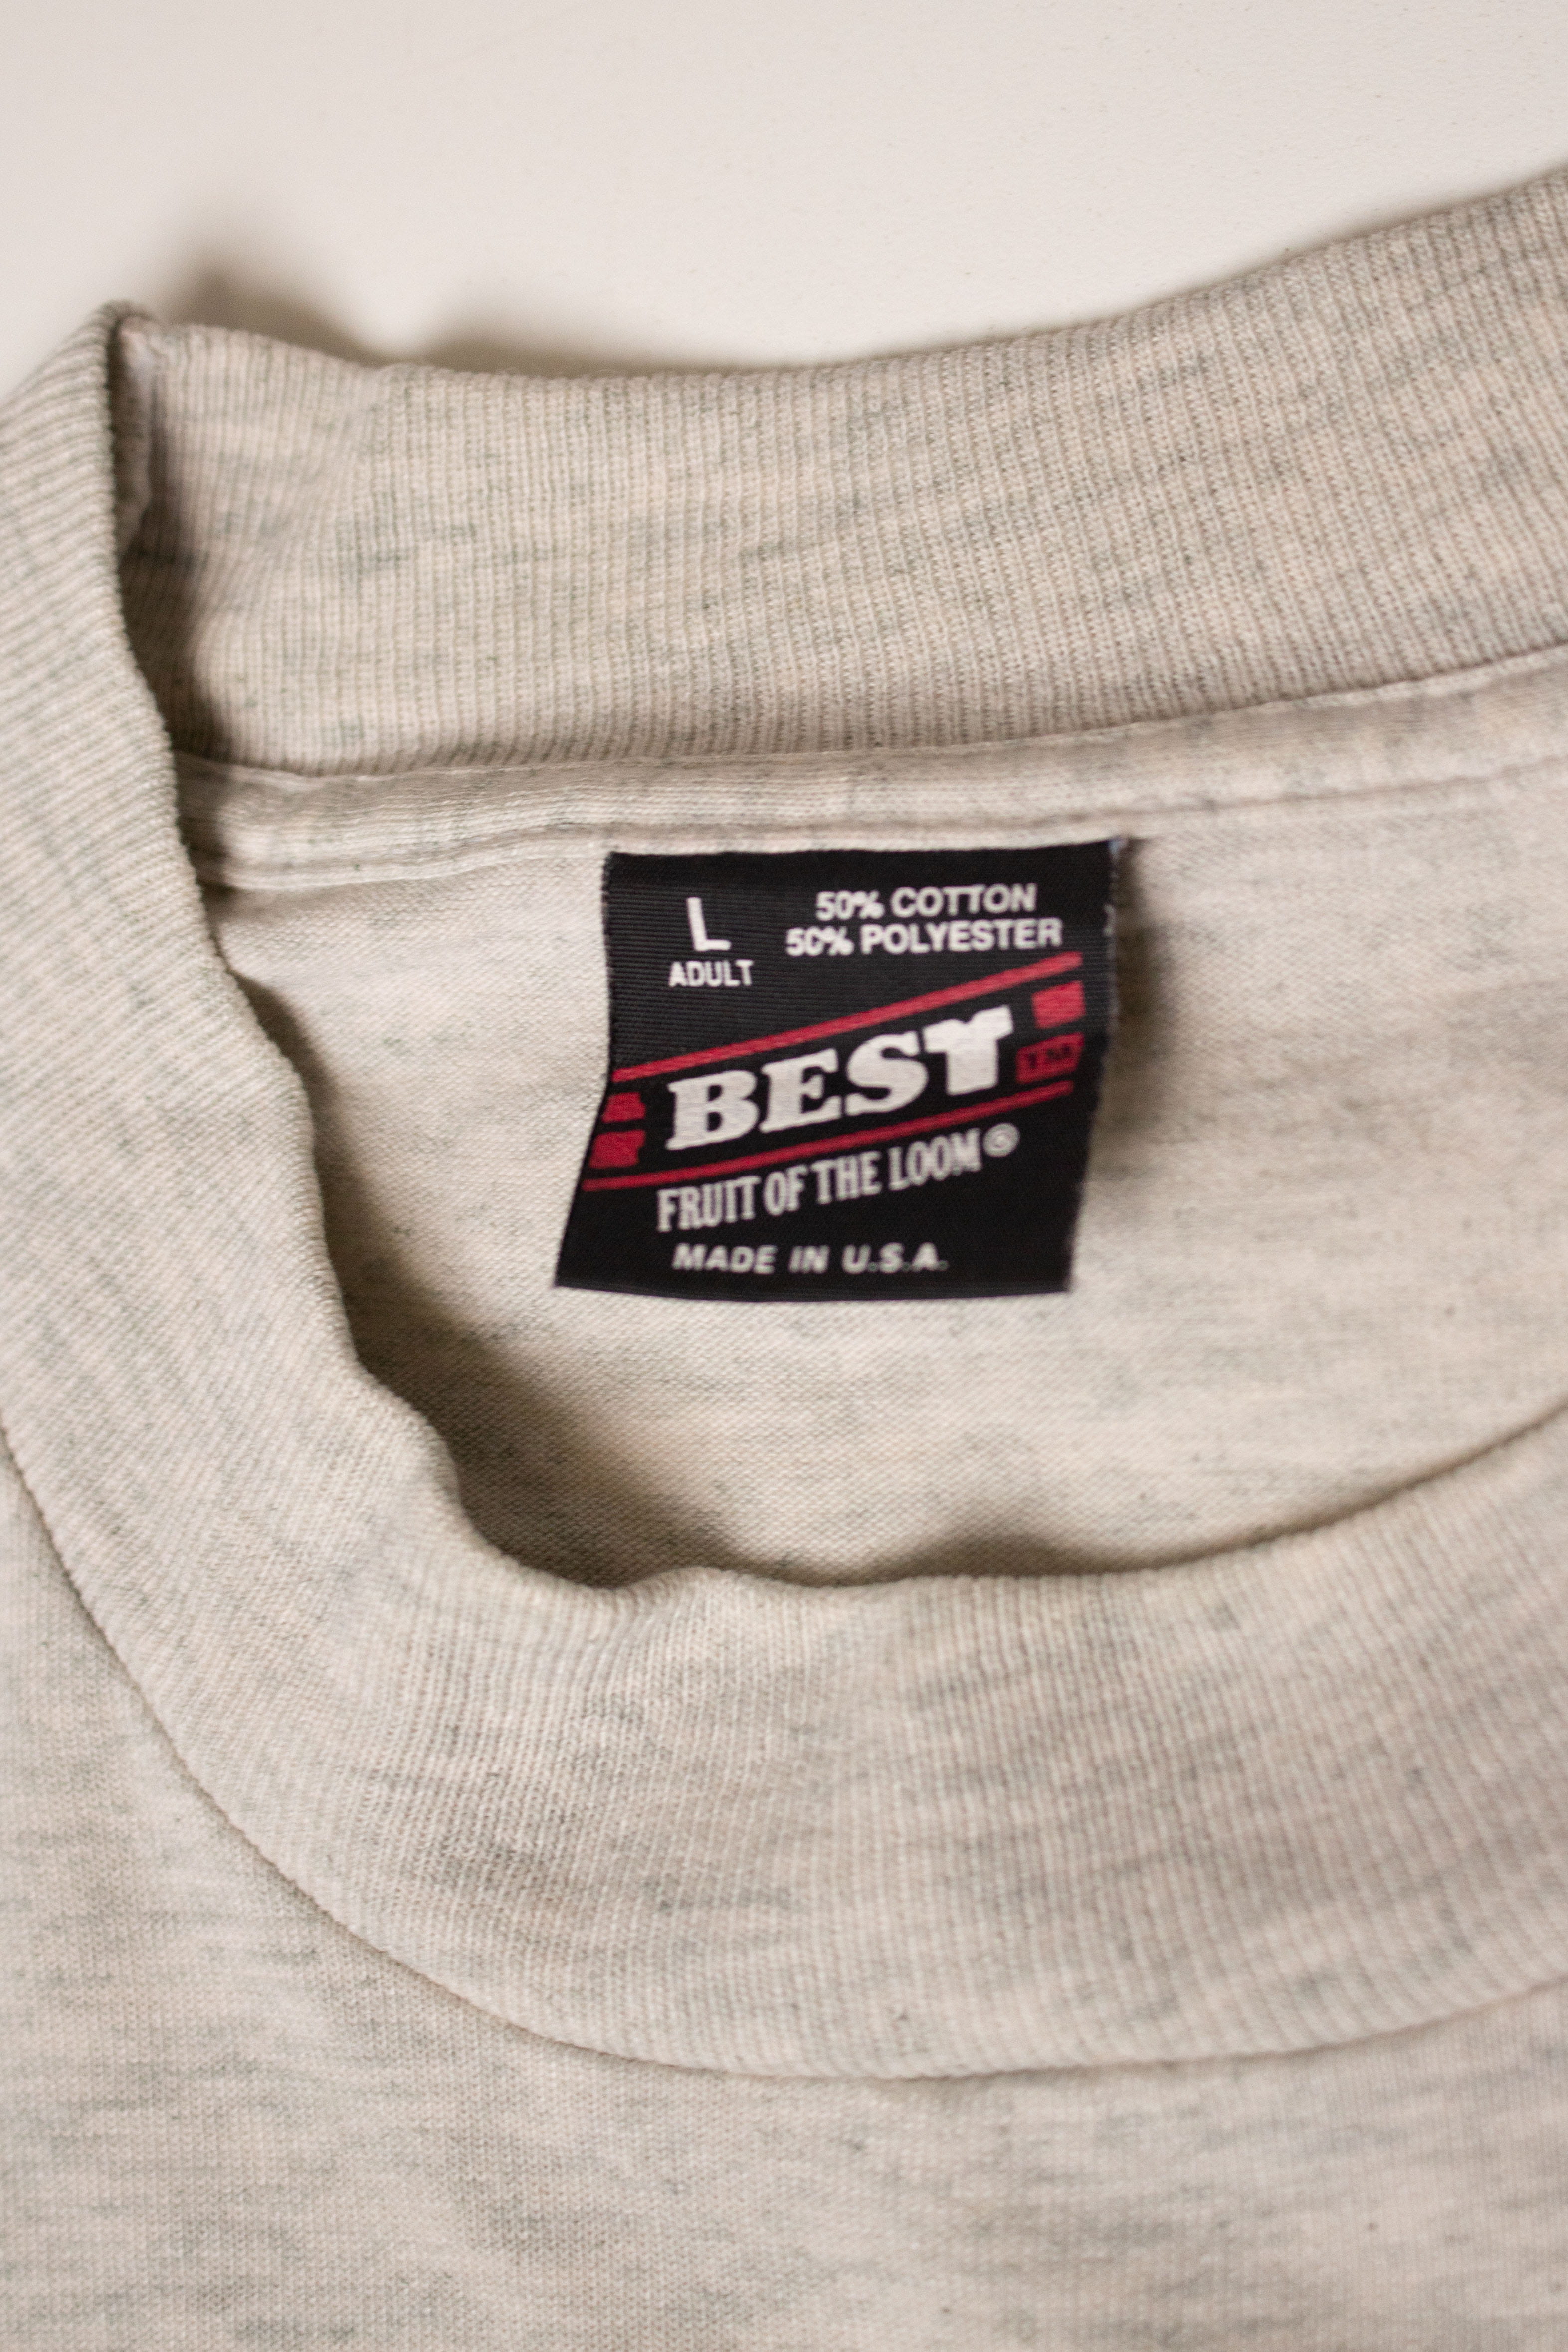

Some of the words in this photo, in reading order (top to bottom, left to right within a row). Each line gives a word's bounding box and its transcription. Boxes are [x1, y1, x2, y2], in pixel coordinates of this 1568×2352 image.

[815, 890, 884, 921] 50%
[890, 883, 1038, 917] COTTON
[686, 897, 732, 951] L
[785, 926, 855, 957] 50%
[860, 917, 1063, 955] POLYESTER
[668, 959, 755, 987] ADULT
[666, 1005, 1014, 1150] BEST
[657, 1175, 761, 1233] FRUIT
[762, 1165, 808, 1216] OF
[812, 1151, 882, 1204] THE
[672, 1243, 777, 1274] MADE
[789, 1245, 829, 1273] IN
[841, 1242, 949, 1275] U.S.A.
